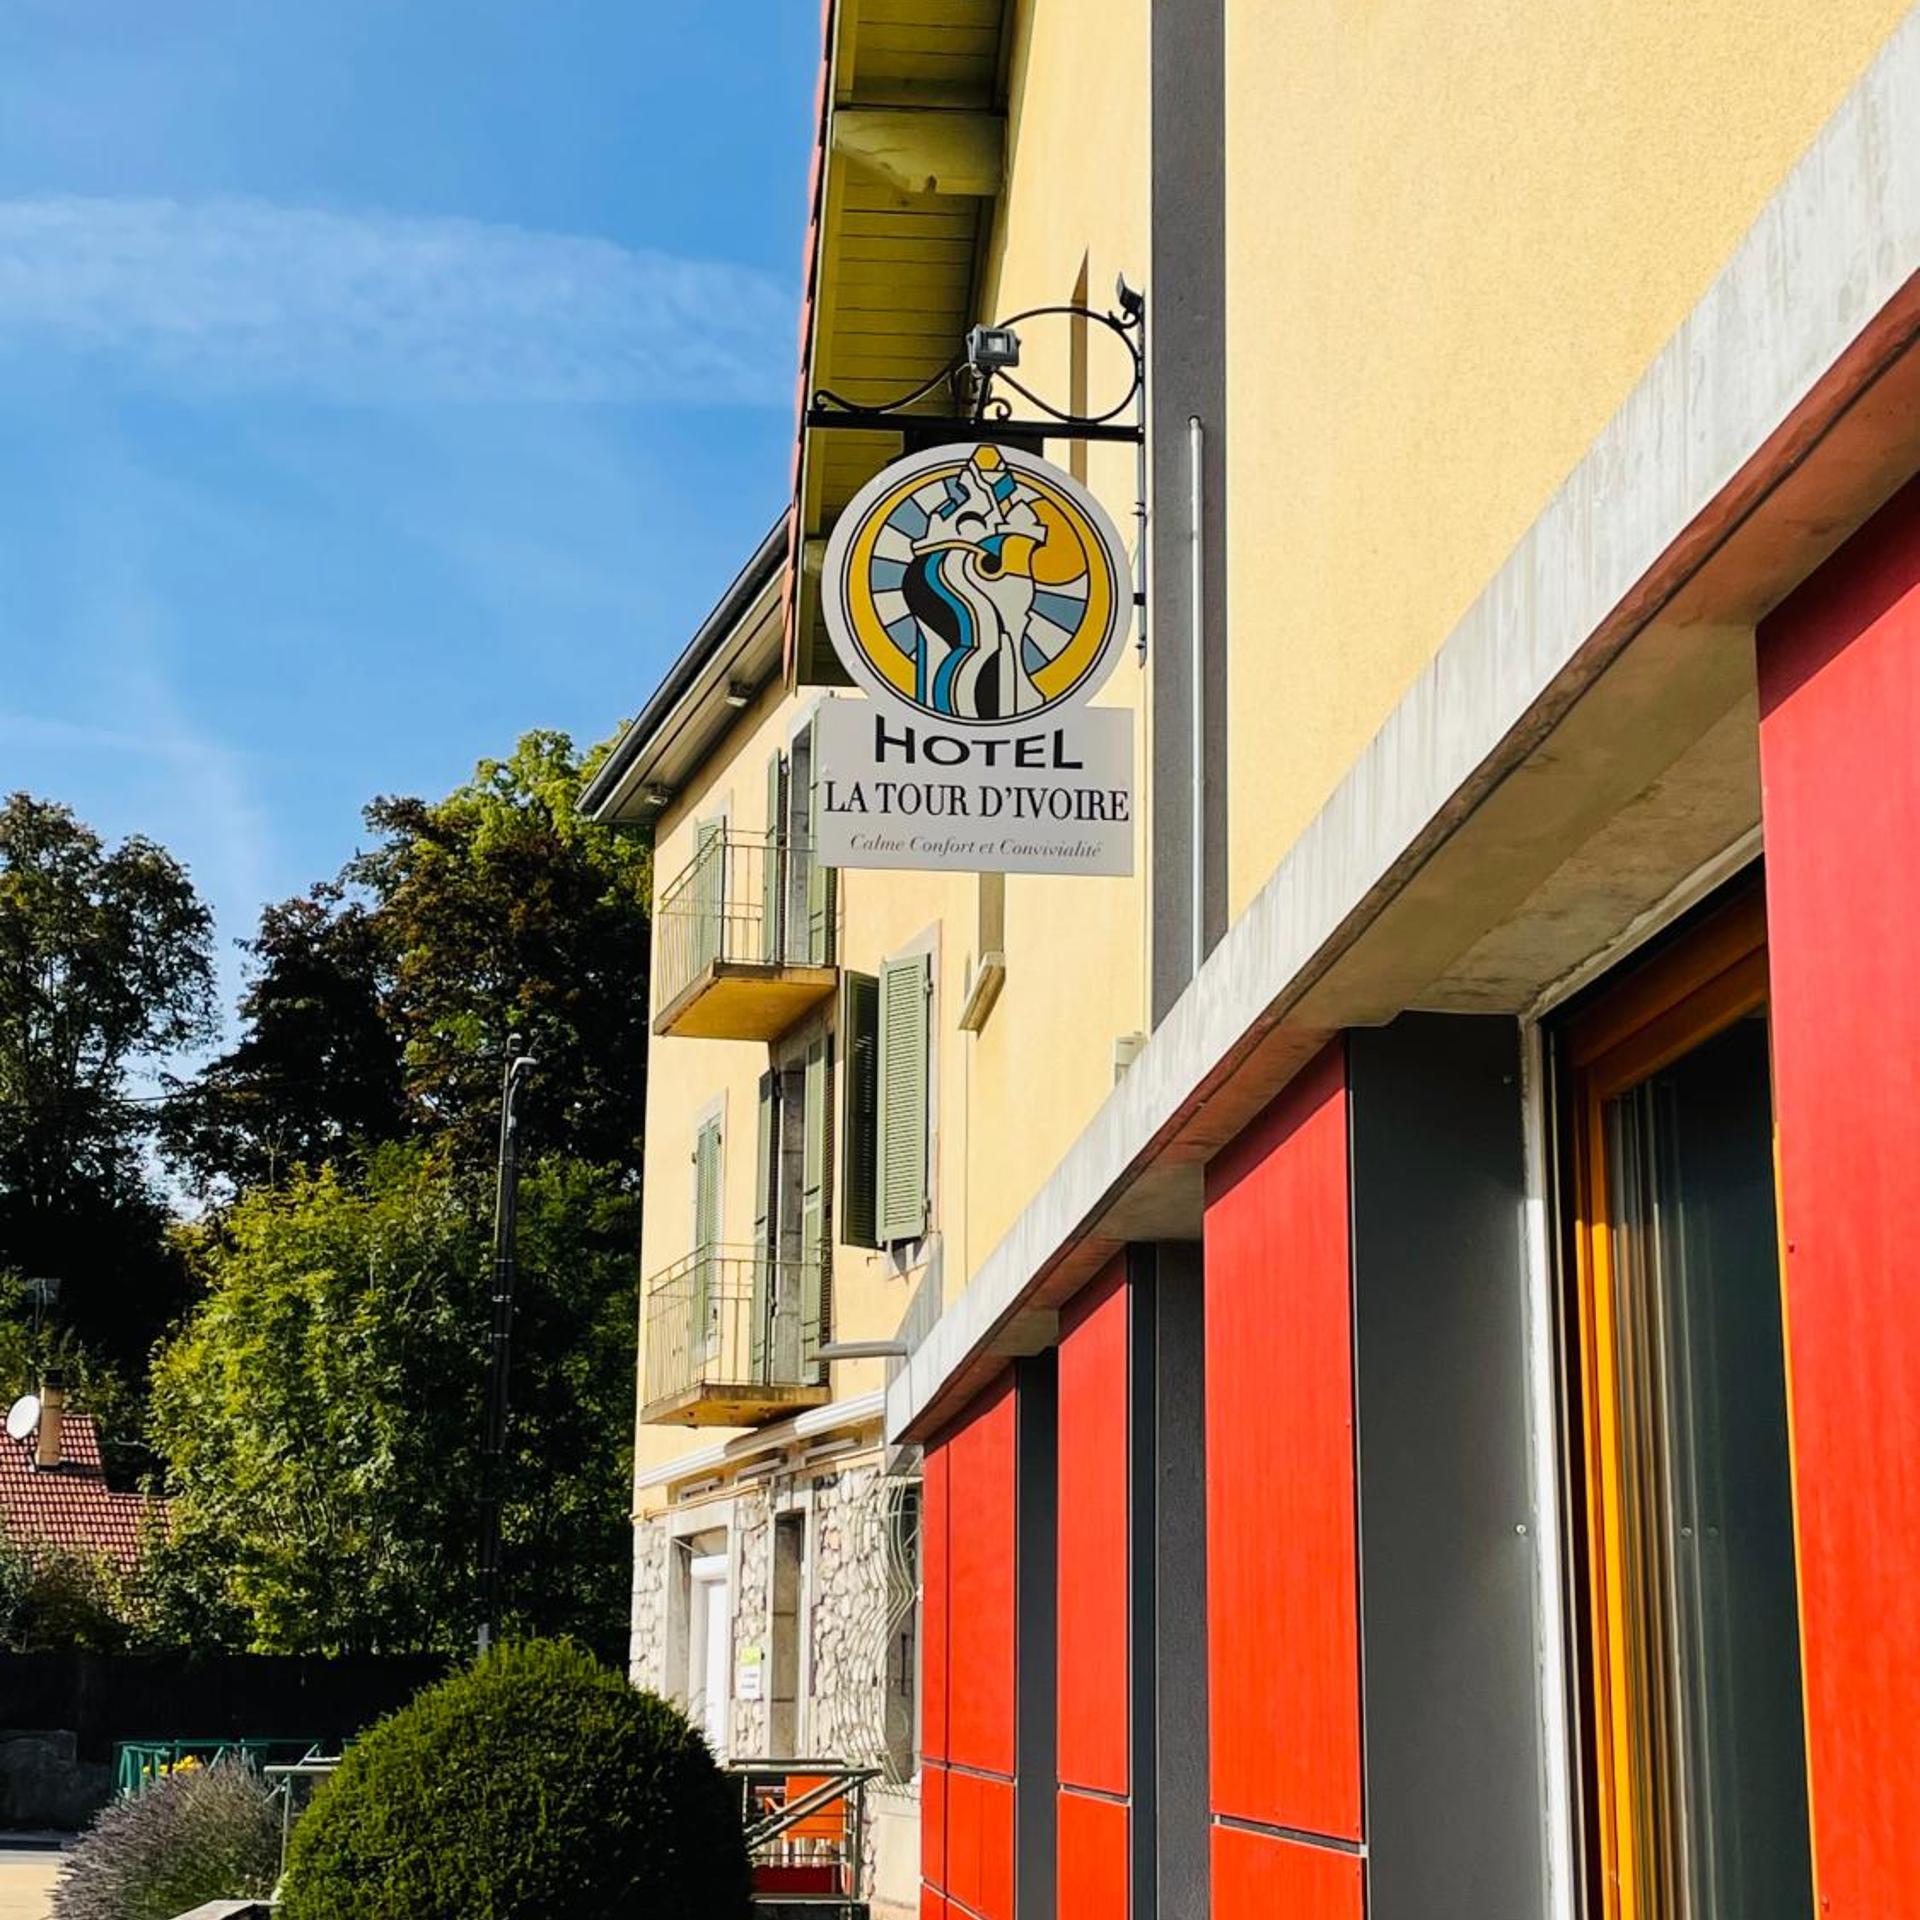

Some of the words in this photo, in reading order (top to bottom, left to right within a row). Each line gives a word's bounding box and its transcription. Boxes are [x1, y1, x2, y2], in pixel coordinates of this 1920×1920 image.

[875, 714, 1083, 769] HOTEL
[824, 780, 868, 812] LA
[875, 782, 969, 816] TOUR
[979, 785, 1129, 821] D'IVOIRE
[850, 834, 903, 852] Calme
[909, 836, 975, 856] Confort
[979, 840, 993, 854] et
[999, 838, 1102, 857] Convivialité
